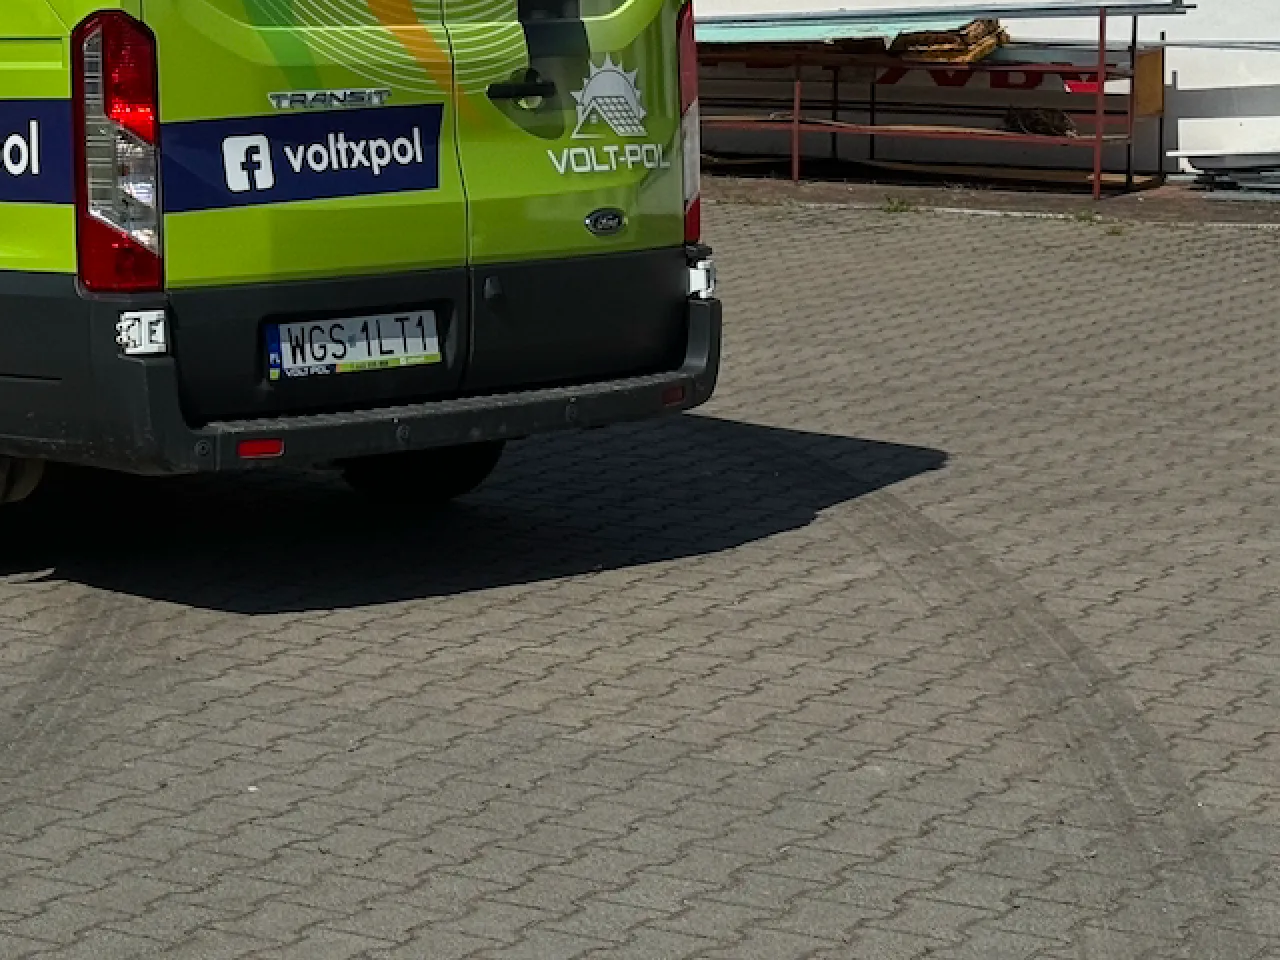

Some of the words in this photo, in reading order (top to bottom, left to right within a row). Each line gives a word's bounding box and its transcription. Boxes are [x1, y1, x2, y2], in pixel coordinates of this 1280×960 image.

[268, 88, 392, 109] TRANSIT
[284, 127, 423, 176] voltxpol
[547, 143, 671, 176] VOLT-POL
[287, 323, 348, 365] WGS
[360, 315, 428, 357] 1LT1
